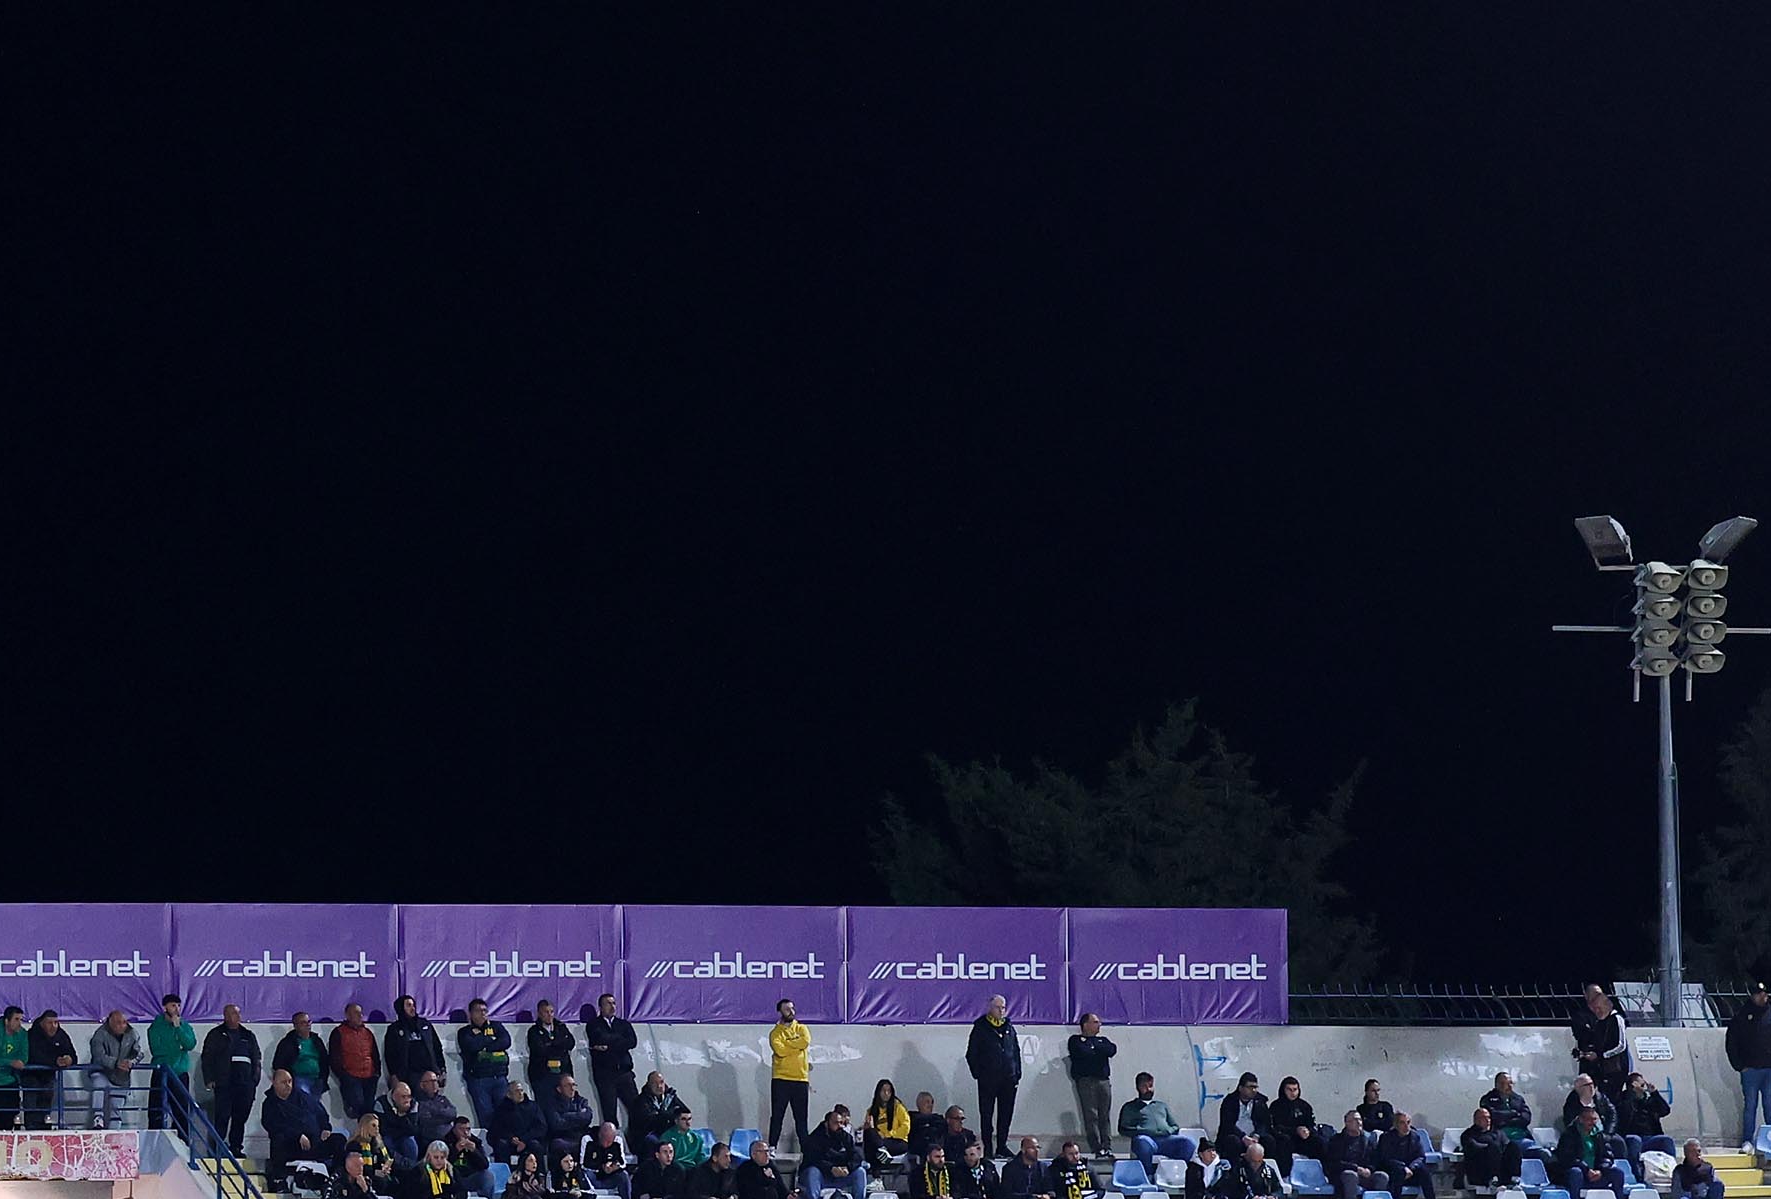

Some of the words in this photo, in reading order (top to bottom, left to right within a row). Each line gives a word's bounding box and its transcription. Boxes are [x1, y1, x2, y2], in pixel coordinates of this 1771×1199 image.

[222, 950, 376, 978] cablenet
[449, 950, 601, 978] cablenet
[673, 951, 825, 979] cablenet
[896, 953, 1046, 980] cablenet
[1117, 954, 1267, 980] cablenet
